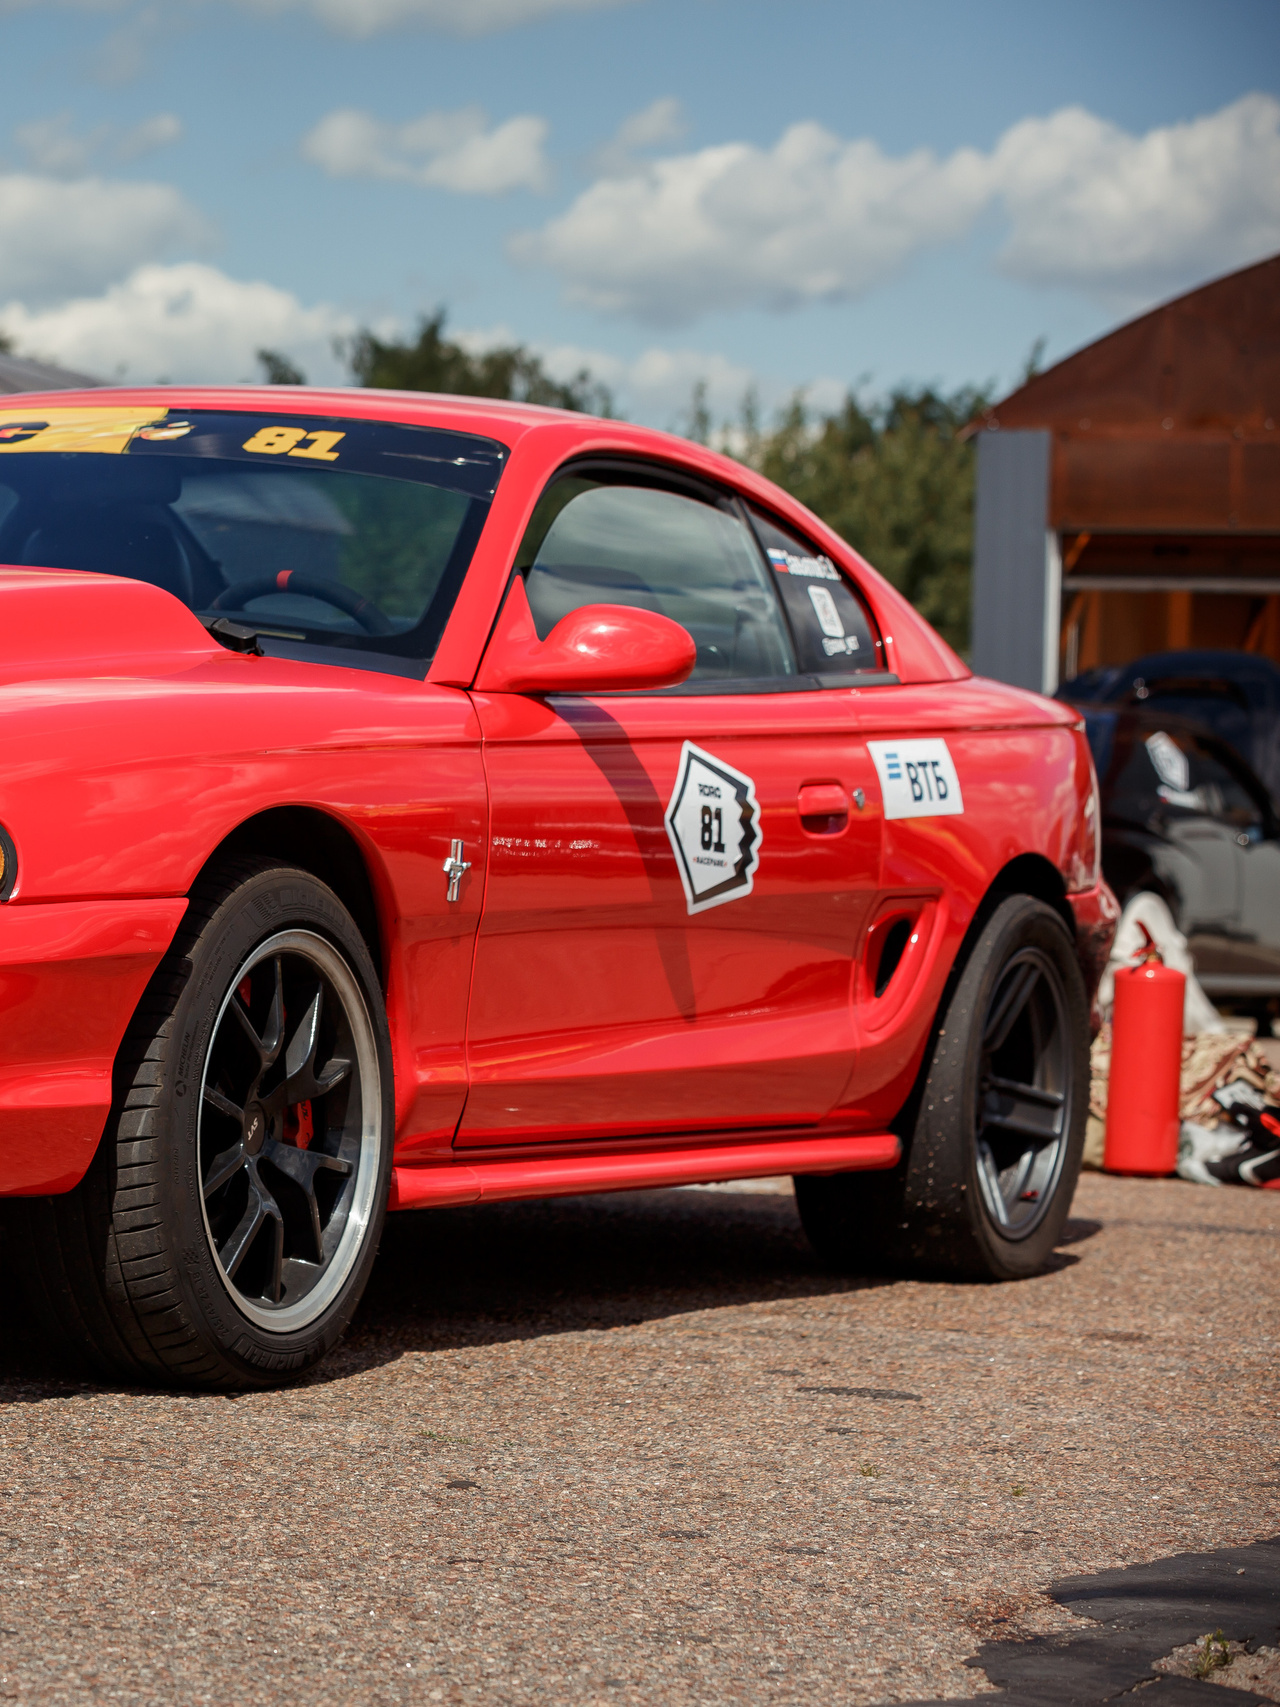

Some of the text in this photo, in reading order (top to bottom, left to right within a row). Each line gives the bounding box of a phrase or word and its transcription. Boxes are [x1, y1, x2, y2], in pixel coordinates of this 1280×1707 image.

[241, 425, 347, 462] 81
[905, 760, 949, 802] ВТБ
[701, 805, 726, 854] 81
[179, 1032, 192, 1077] MICHELIN
[192, 1271, 203, 1285] 18
